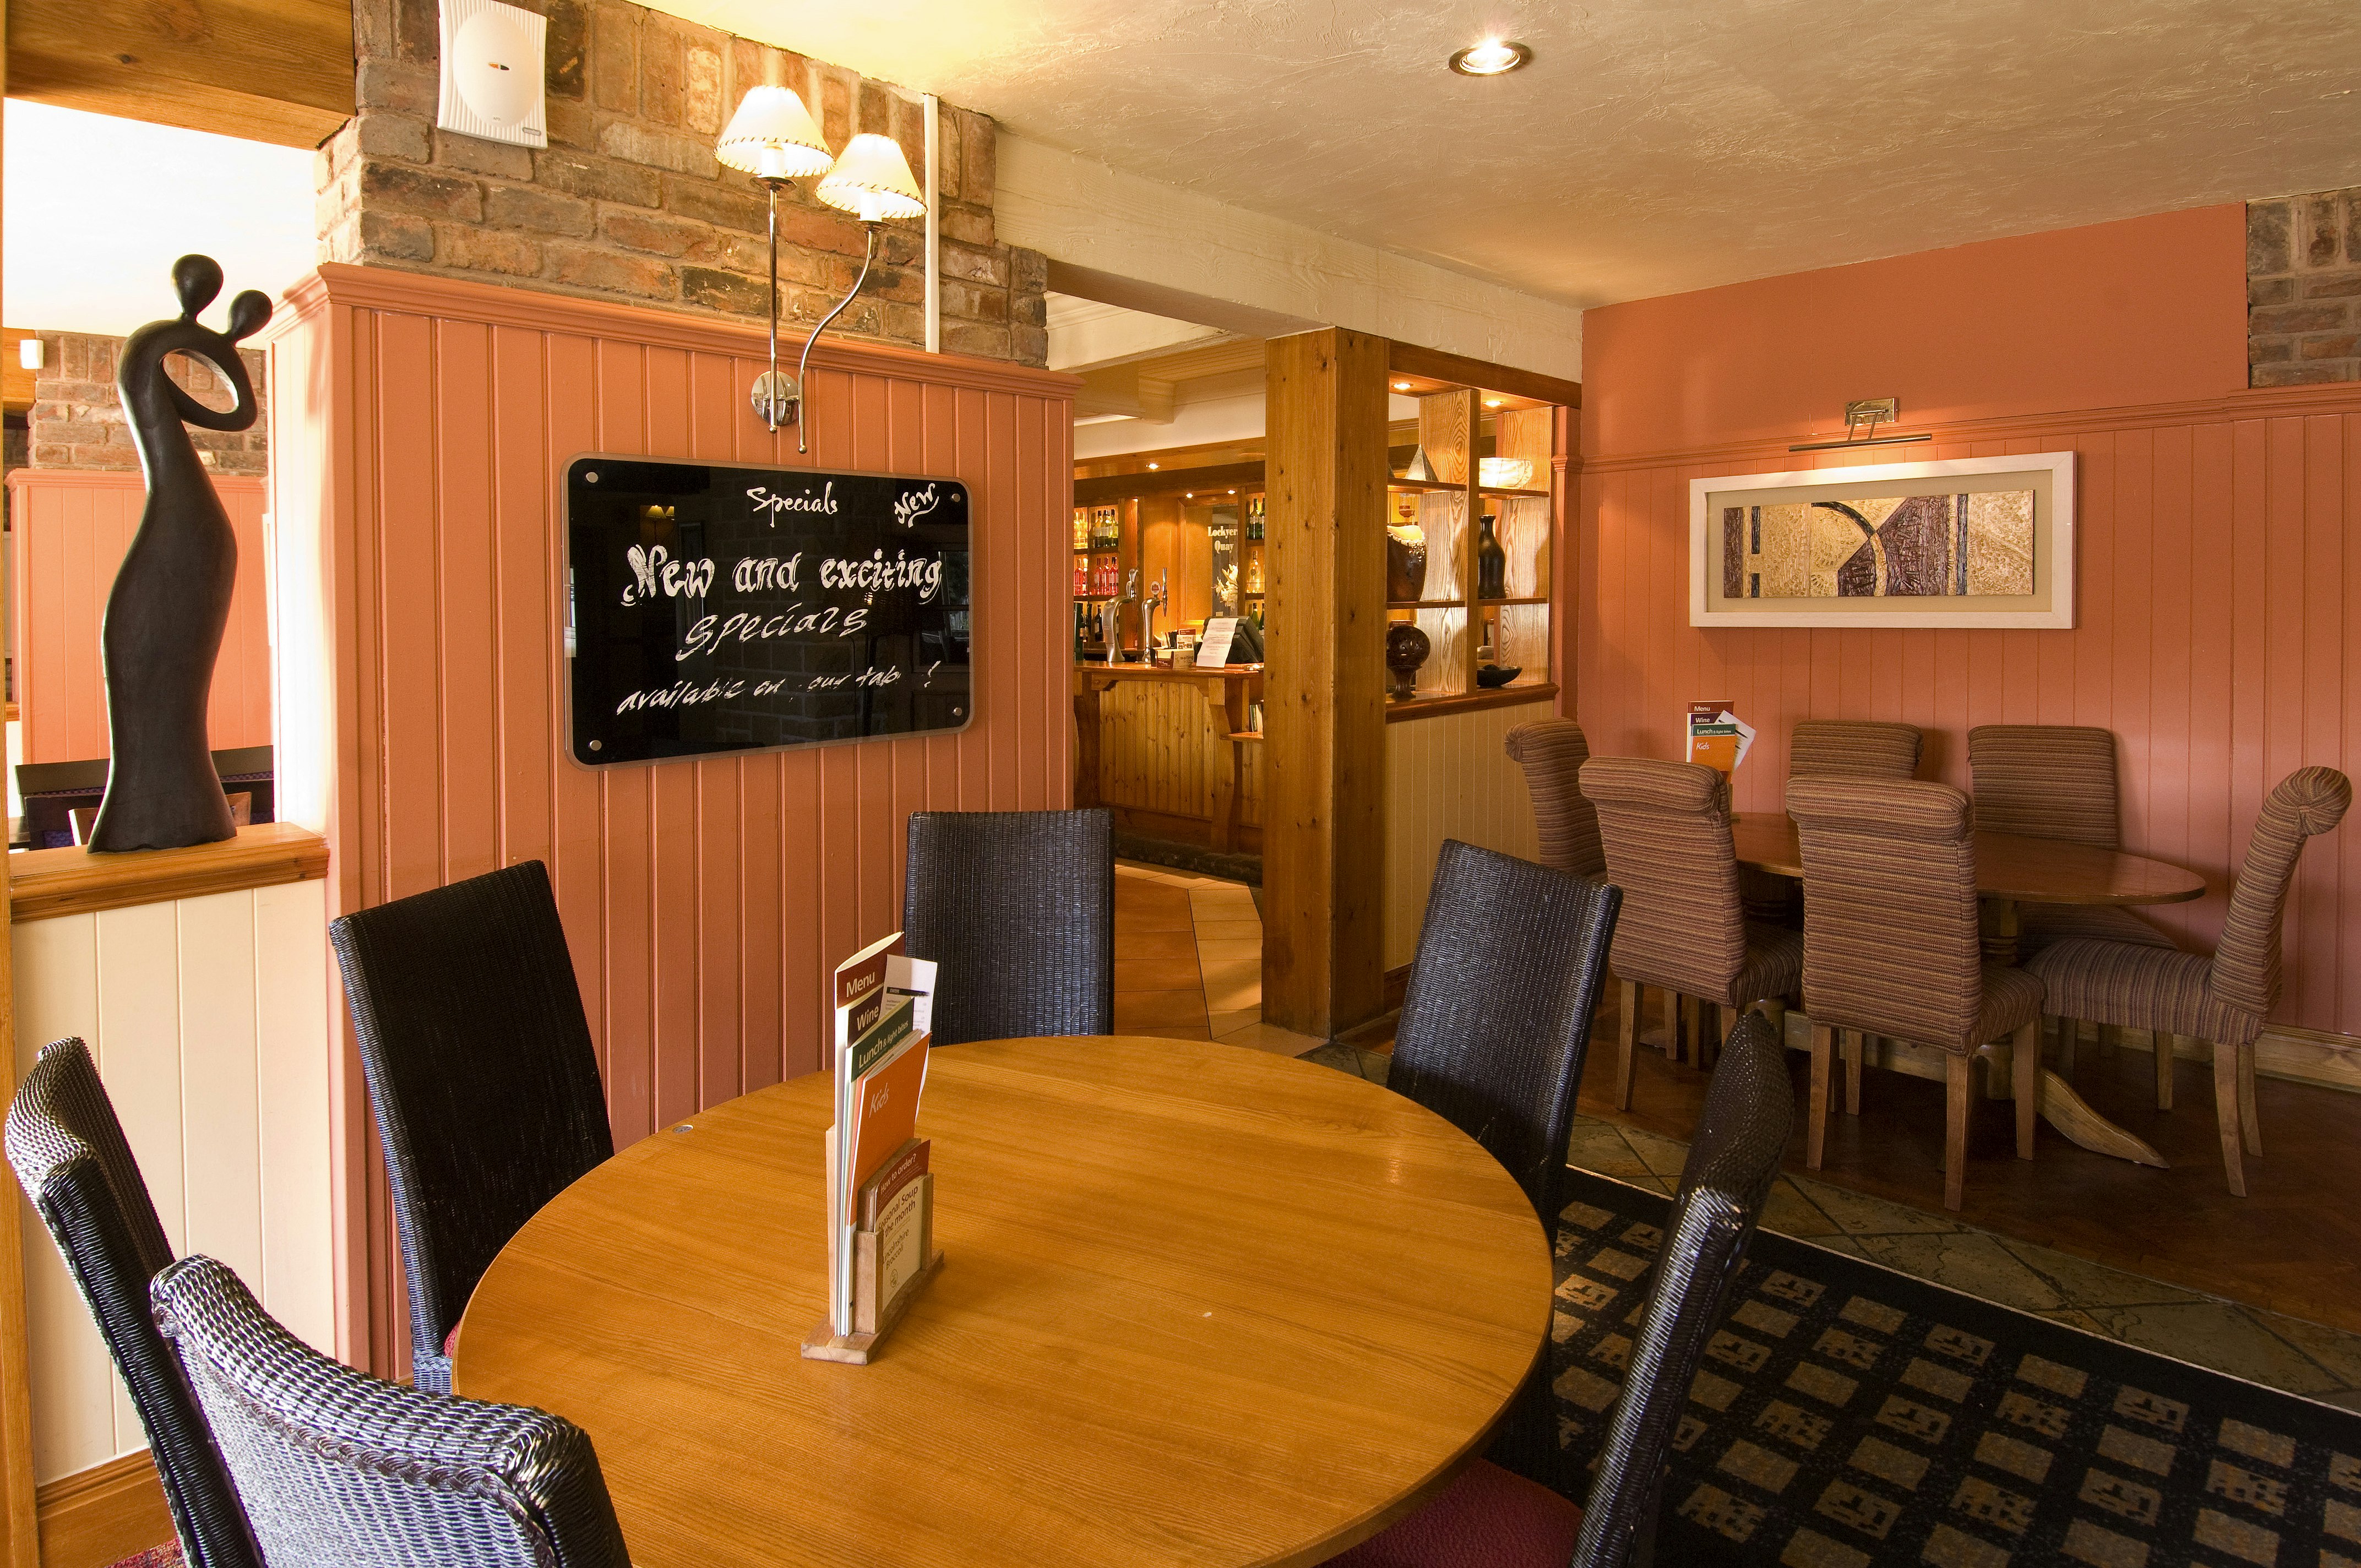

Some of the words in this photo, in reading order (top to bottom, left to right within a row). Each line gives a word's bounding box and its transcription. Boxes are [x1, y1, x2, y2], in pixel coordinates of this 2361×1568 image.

[747, 481, 838, 527] Specials
[895, 483, 939, 528] New
[1207, 525, 1238, 539] Lockyer
[1214, 540, 1234, 554] Quay
[621, 544, 715, 606] New
[732, 552, 802, 593] and
[819, 548, 943, 605] exciting
[1696, 742, 1710, 750] Kids
[846, 972, 875, 998] Menu
[857, 1005, 879, 1031] Wine
[859, 1038, 883, 1069] Lunch
[869, 1082, 889, 1119] Kids
[891, 1172, 897, 1181] to
[898, 1153, 917, 1174] order?
[901, 1186, 918, 1206] Soup
[885, 1222, 894, 1238] the
[895, 1200, 916, 1226] month
